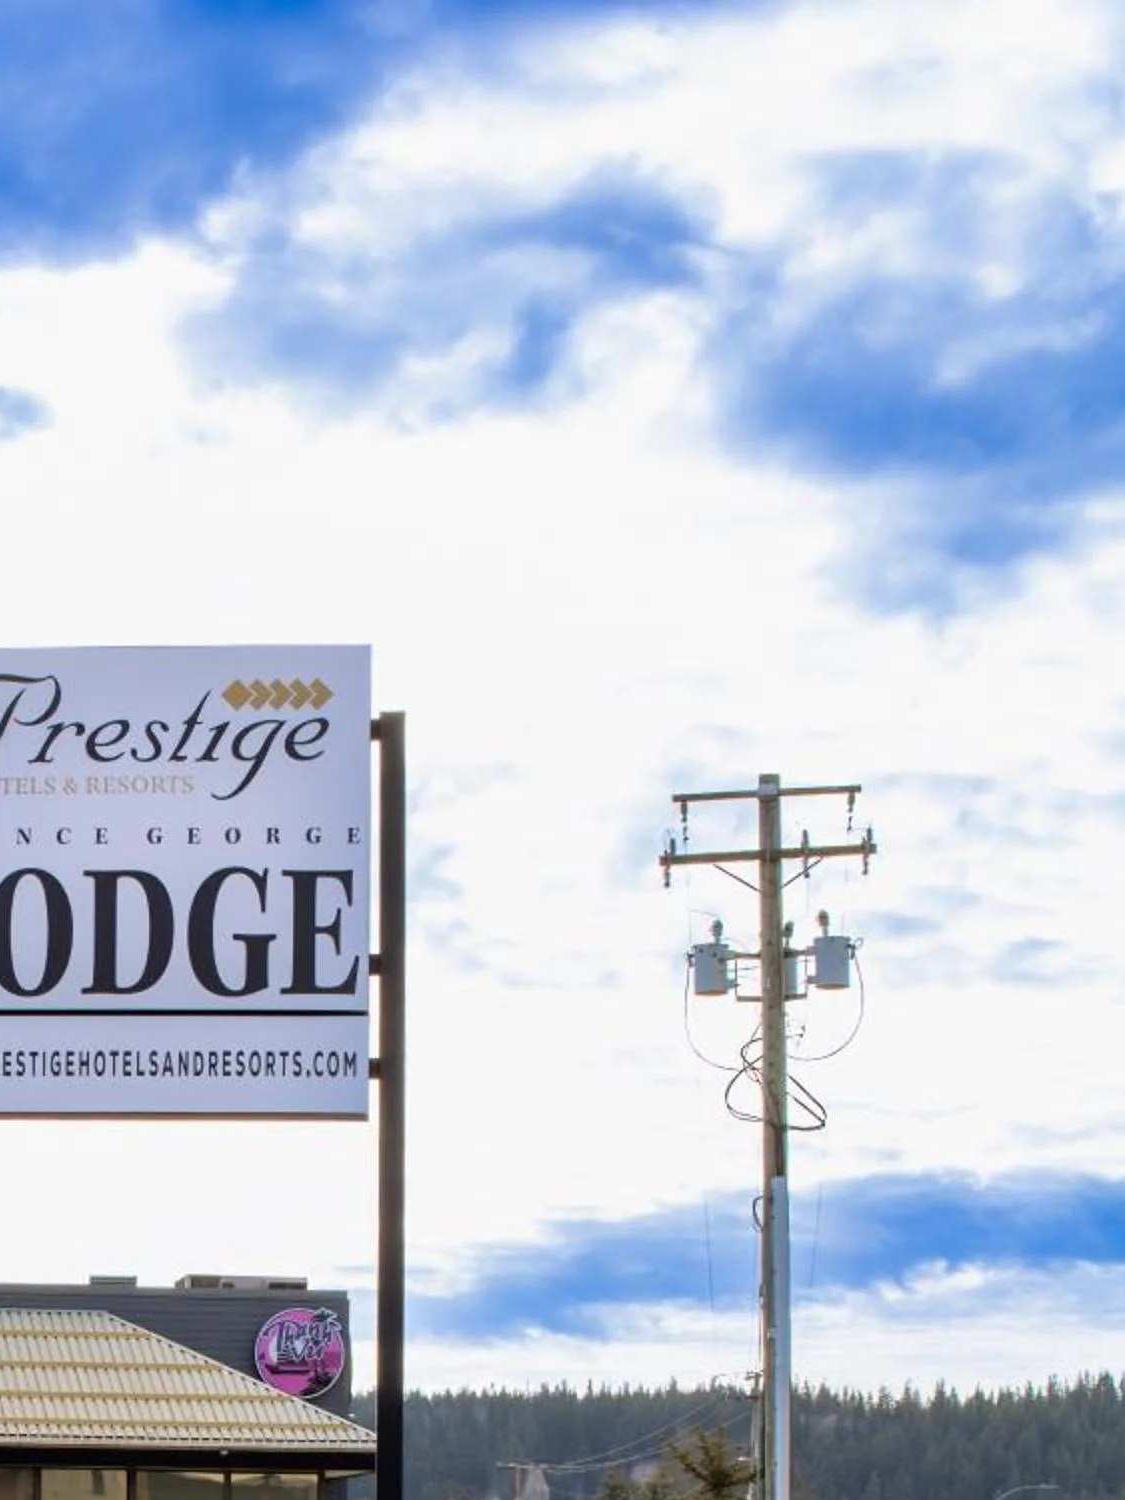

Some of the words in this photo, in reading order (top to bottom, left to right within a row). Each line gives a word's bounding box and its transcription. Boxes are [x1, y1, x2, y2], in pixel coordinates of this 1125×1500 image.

[62, 776, 79, 796] &
[86, 775, 195, 795] RESORTS
[146, 826, 361, 845] GEORGE
